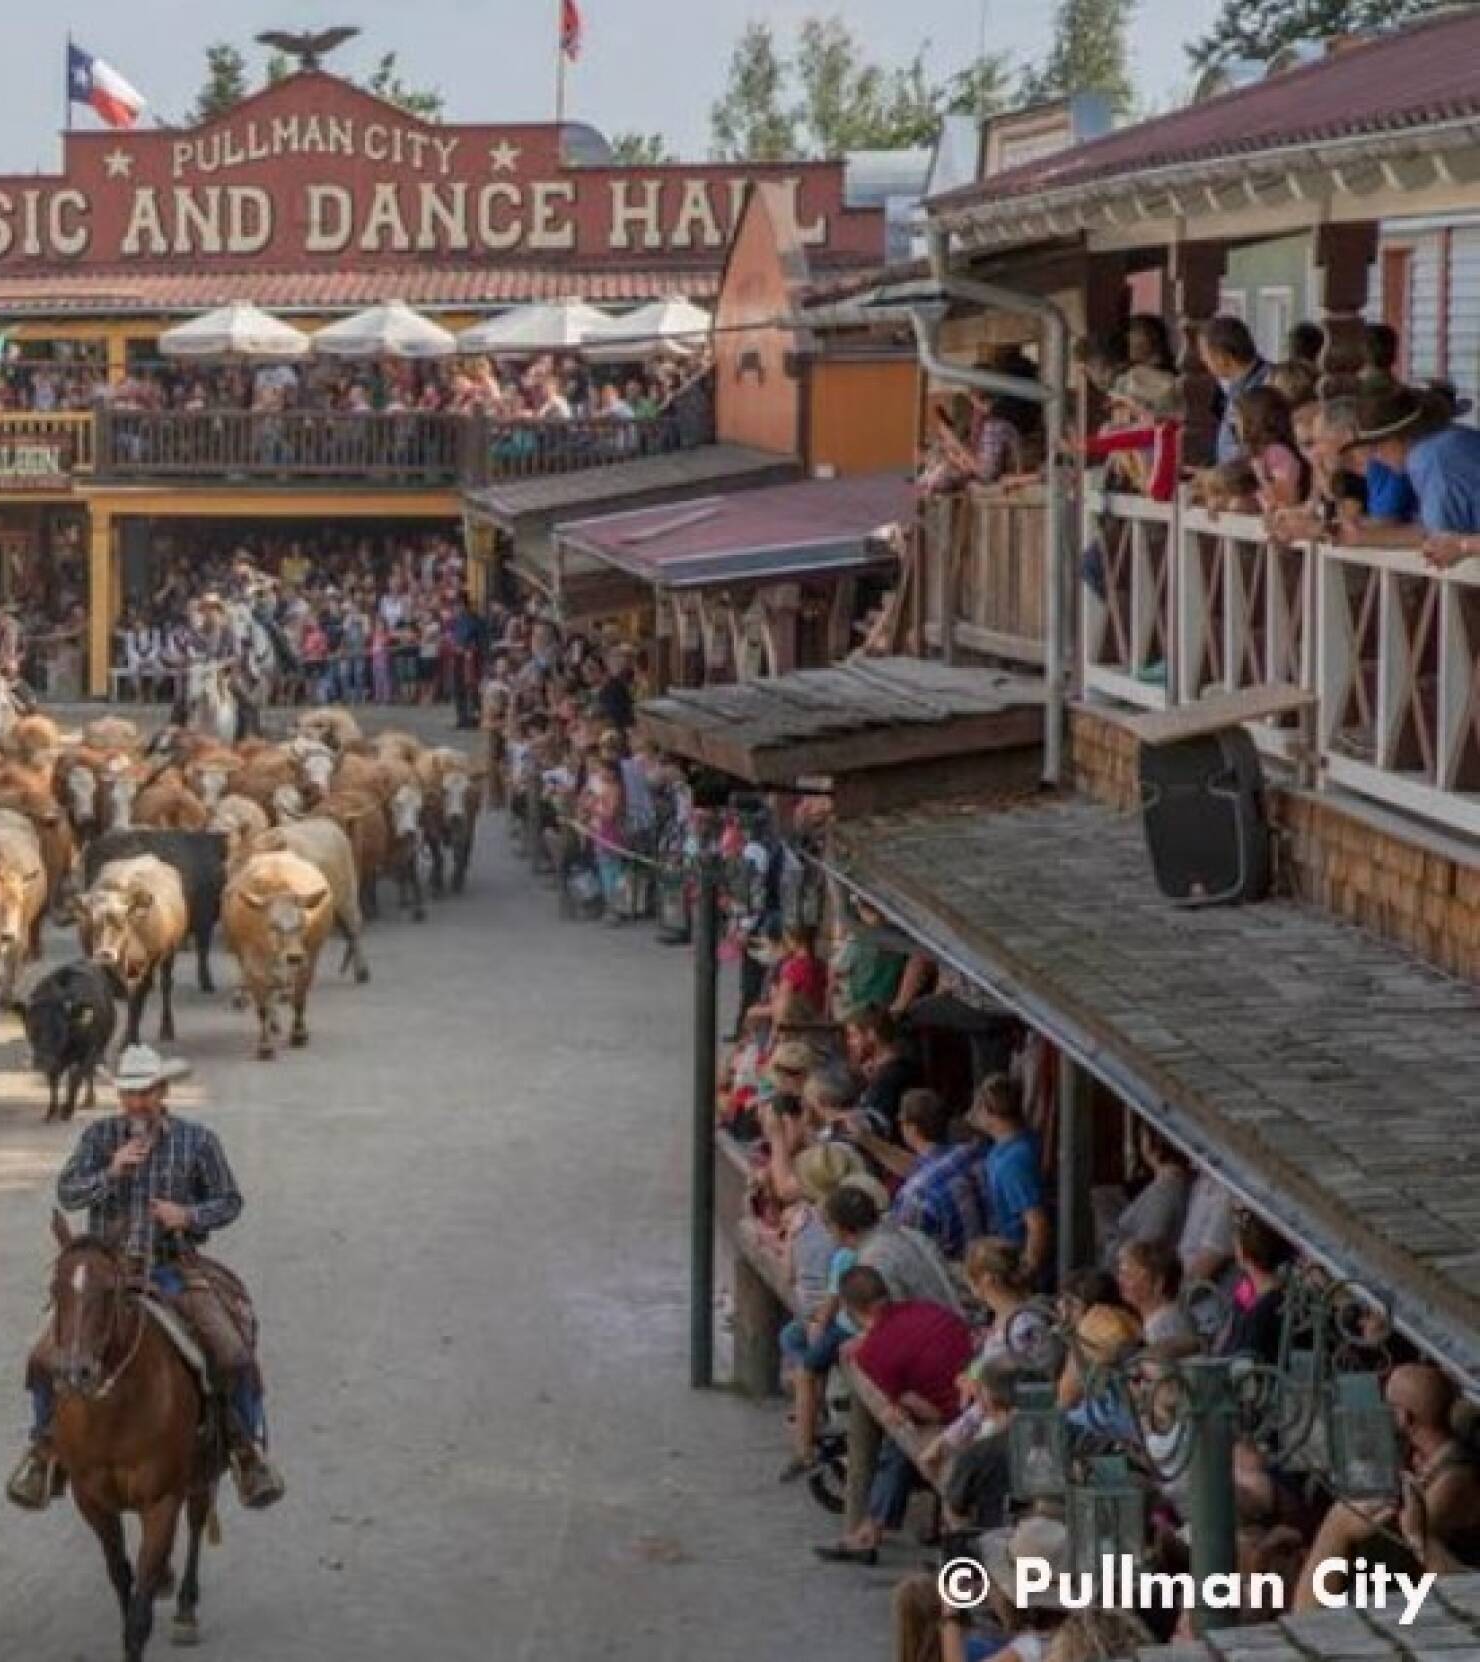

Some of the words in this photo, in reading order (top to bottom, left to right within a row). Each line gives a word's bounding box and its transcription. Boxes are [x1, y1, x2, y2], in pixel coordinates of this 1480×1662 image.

[172, 115, 354, 178] PULLMAN
[364, 123, 460, 174] CITY
[120, 184, 274, 257] AND
[305, 181, 576, 254] DANCE
